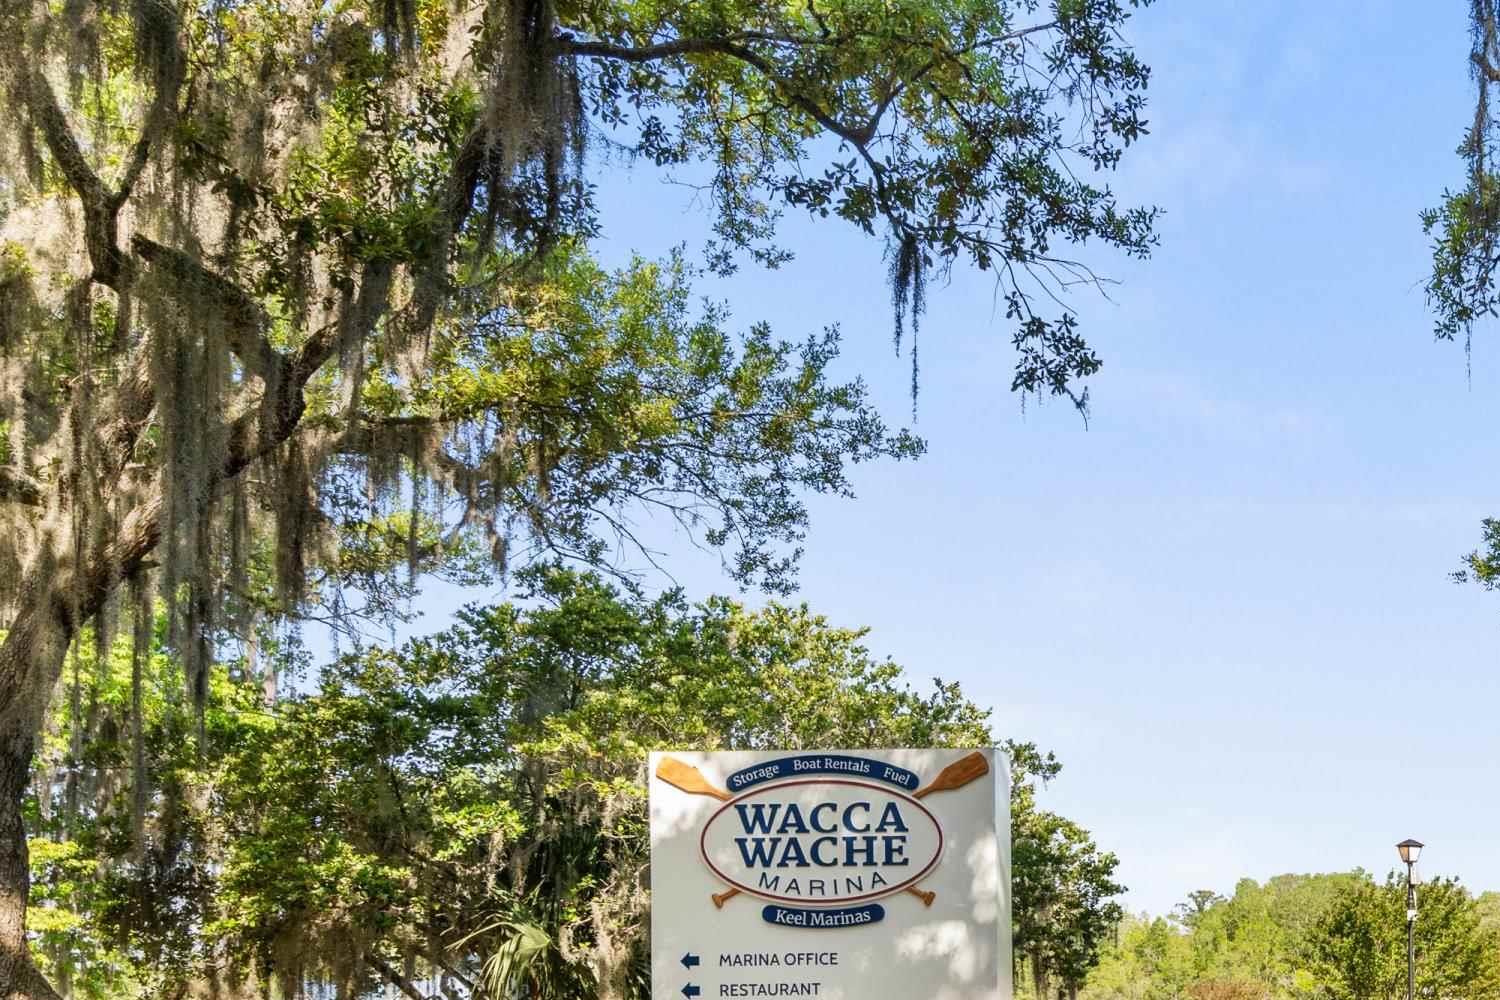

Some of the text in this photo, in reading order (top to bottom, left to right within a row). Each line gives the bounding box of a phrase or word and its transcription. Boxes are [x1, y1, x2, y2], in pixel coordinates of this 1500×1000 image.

[733, 758, 911, 787] Storage Boat Rentals Fuel
[734, 802, 909, 835] WACCA
[734, 835, 909, 868] WACHE
[758, 871, 888, 896] MARINA
[775, 909, 871, 927] Keel Marinas
[719, 952, 839, 967] MARINA OFFICE
[719, 982, 821, 997] RESTAURANT
